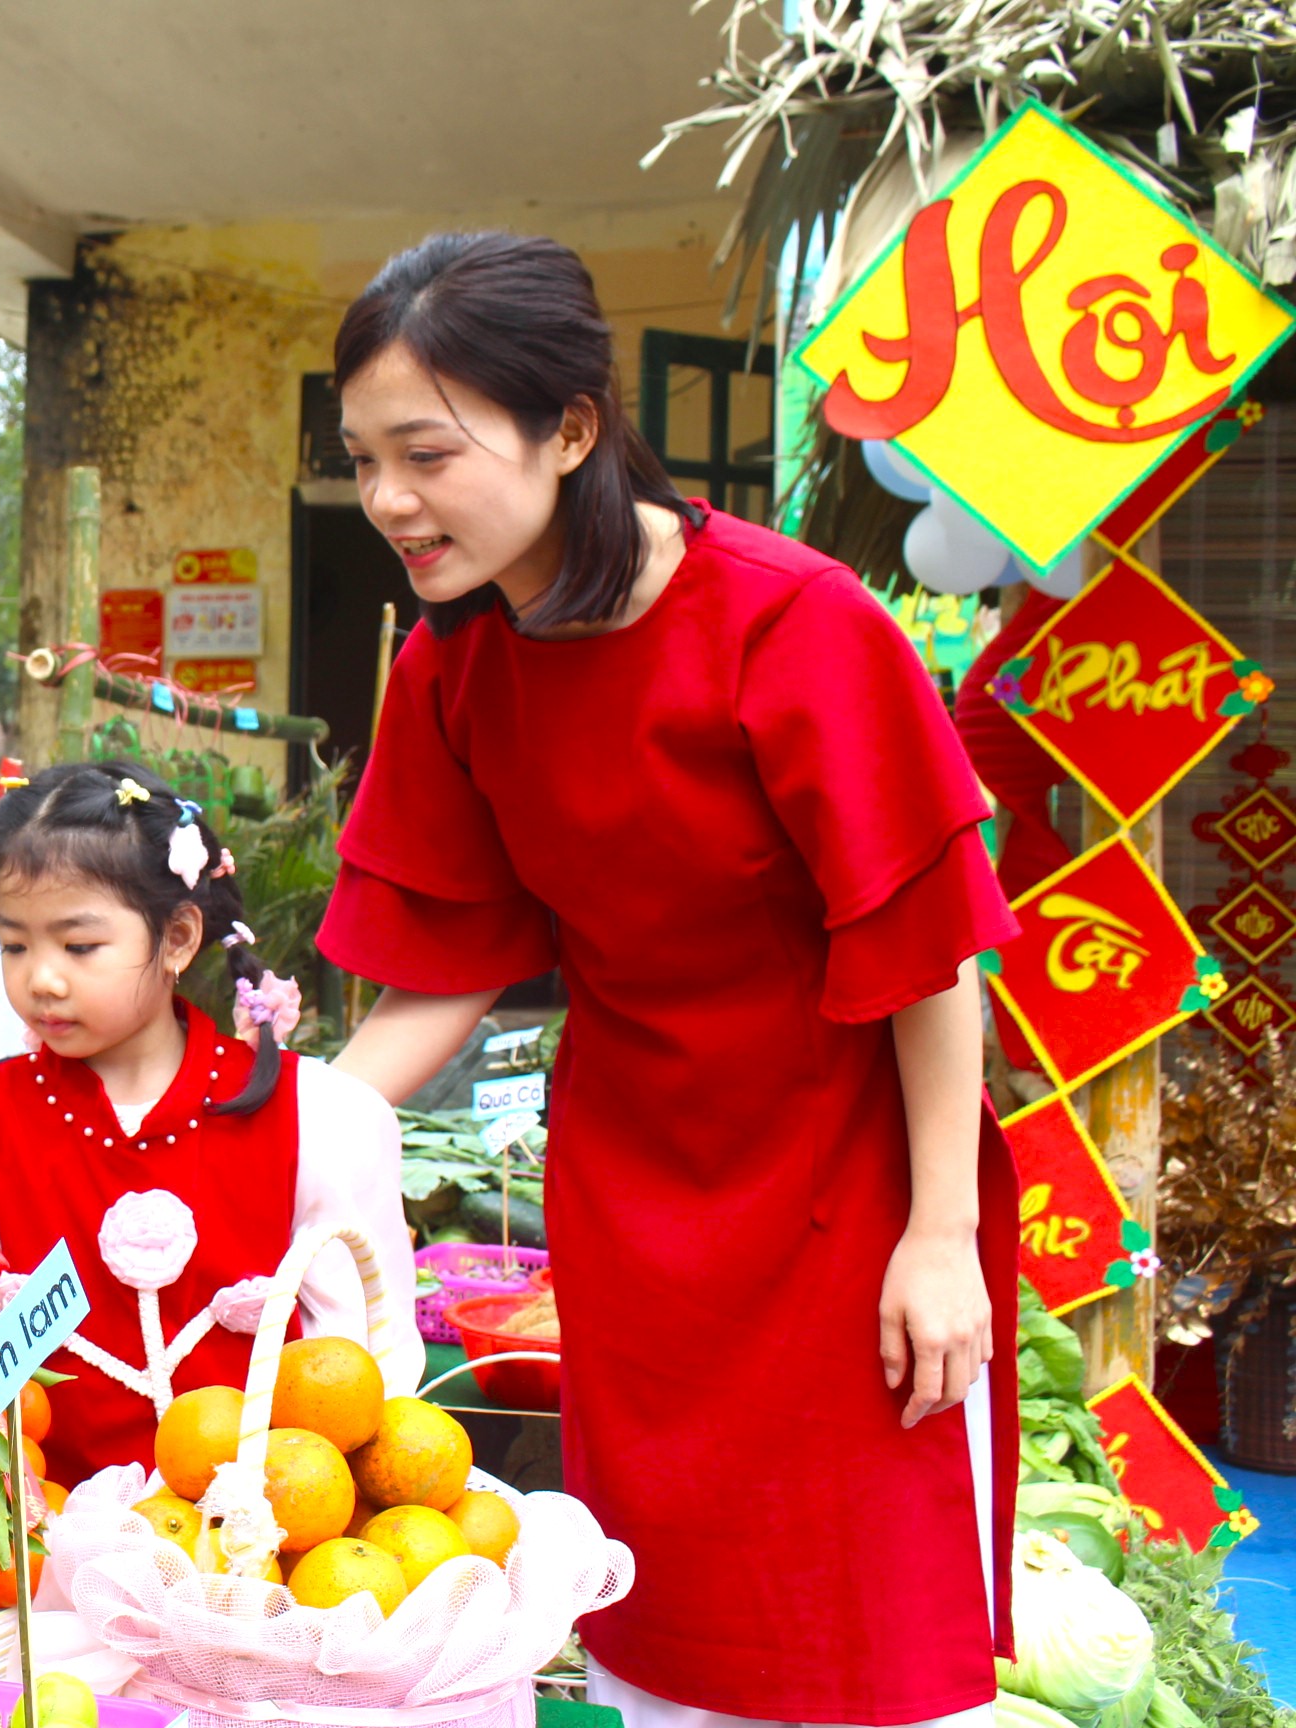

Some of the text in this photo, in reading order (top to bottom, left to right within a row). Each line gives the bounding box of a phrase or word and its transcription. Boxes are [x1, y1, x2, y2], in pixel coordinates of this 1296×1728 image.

[823, 178, 1238, 445] Hội
[1030, 634, 1234, 723] Phát
[19, 1273, 78, 1349] lam
